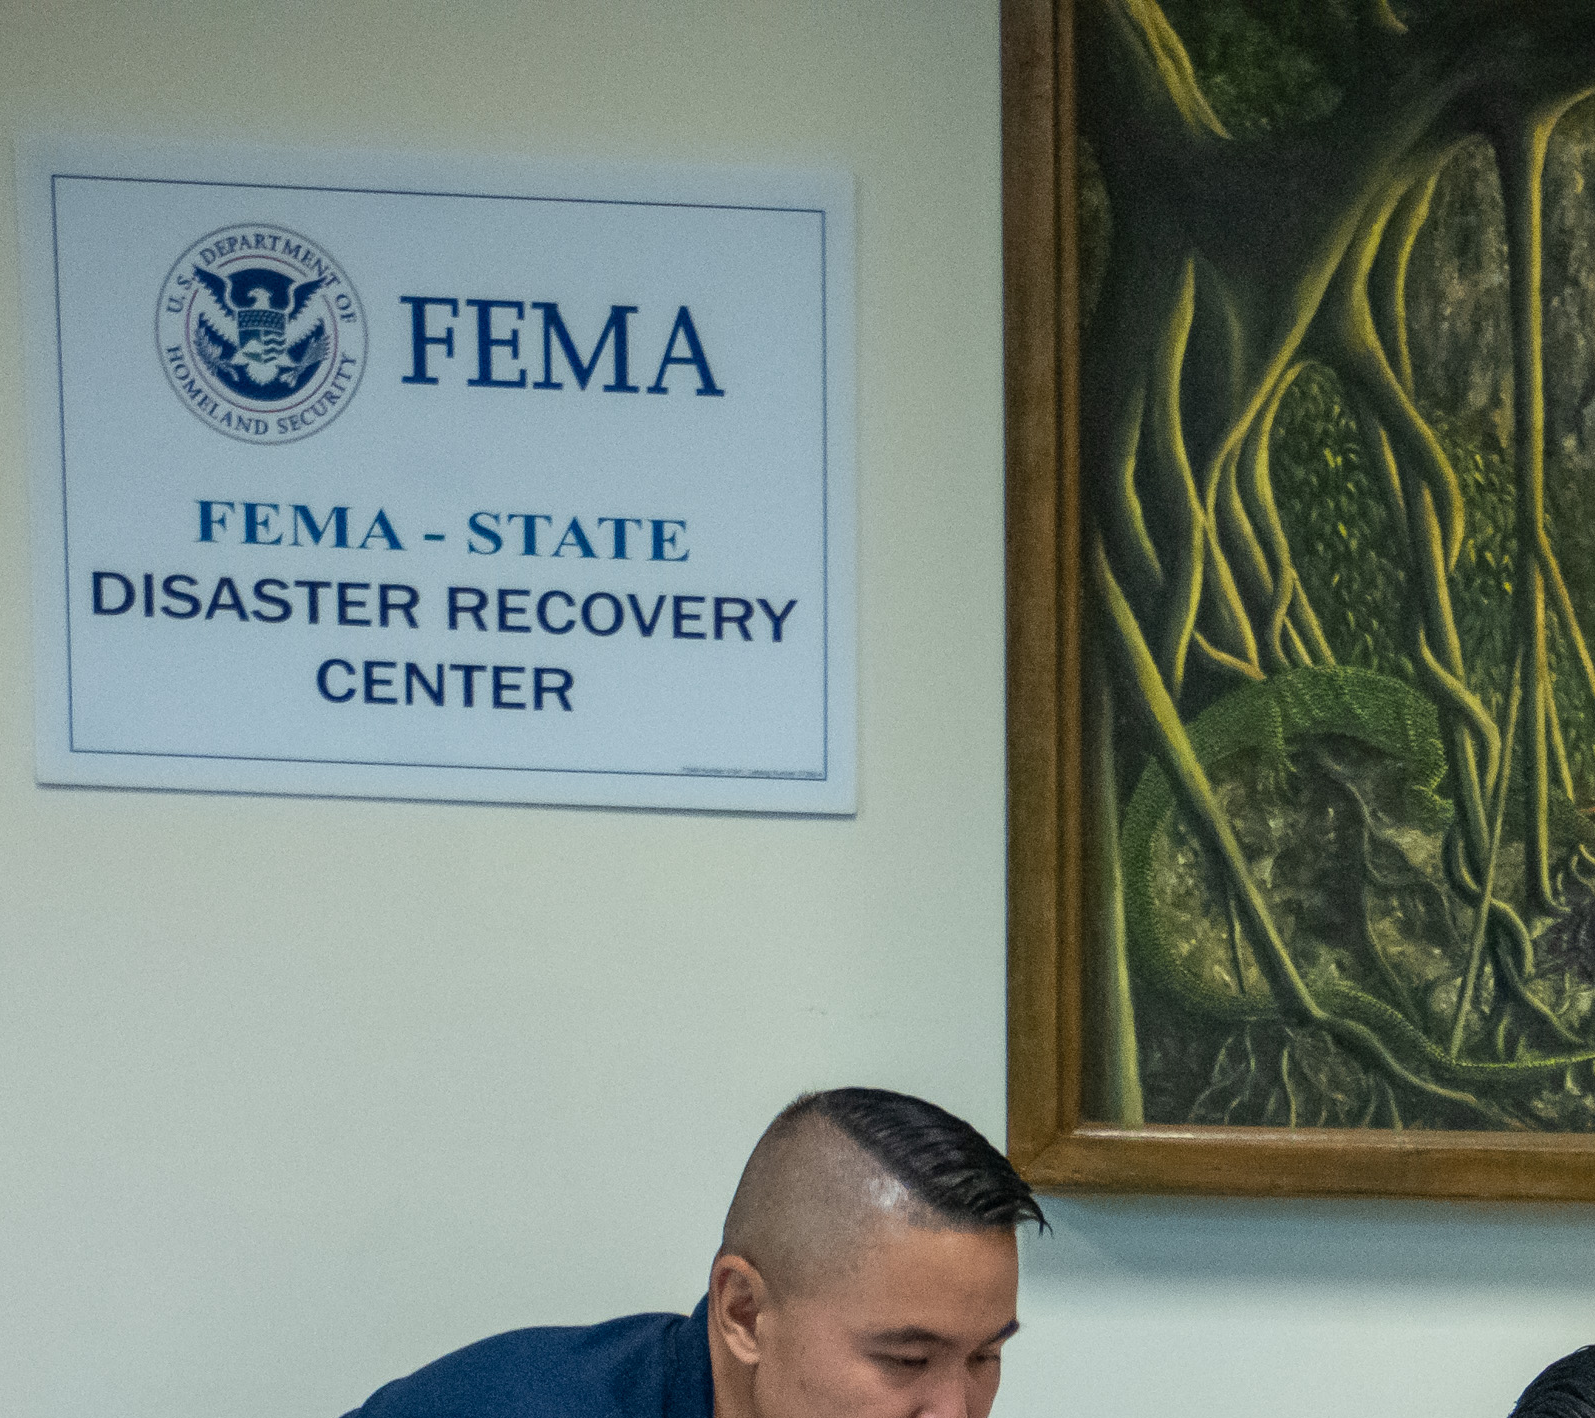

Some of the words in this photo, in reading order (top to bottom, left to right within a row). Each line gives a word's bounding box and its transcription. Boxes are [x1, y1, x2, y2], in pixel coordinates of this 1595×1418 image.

[199, 233, 341, 289] DEPARTMENT
[334, 293, 357, 324] OF
[398, 294, 725, 399] FEMA
[166, 347, 268, 435] HOMELAND
[276, 356, 357, 434] SECURITY
[193, 498, 408, 552] FEMA
[466, 511, 691, 563] STATE
[90, 570, 420, 631] DISASTER
[447, 586, 797, 645] RECOVERY
[316, 658, 574, 712] CENTER
